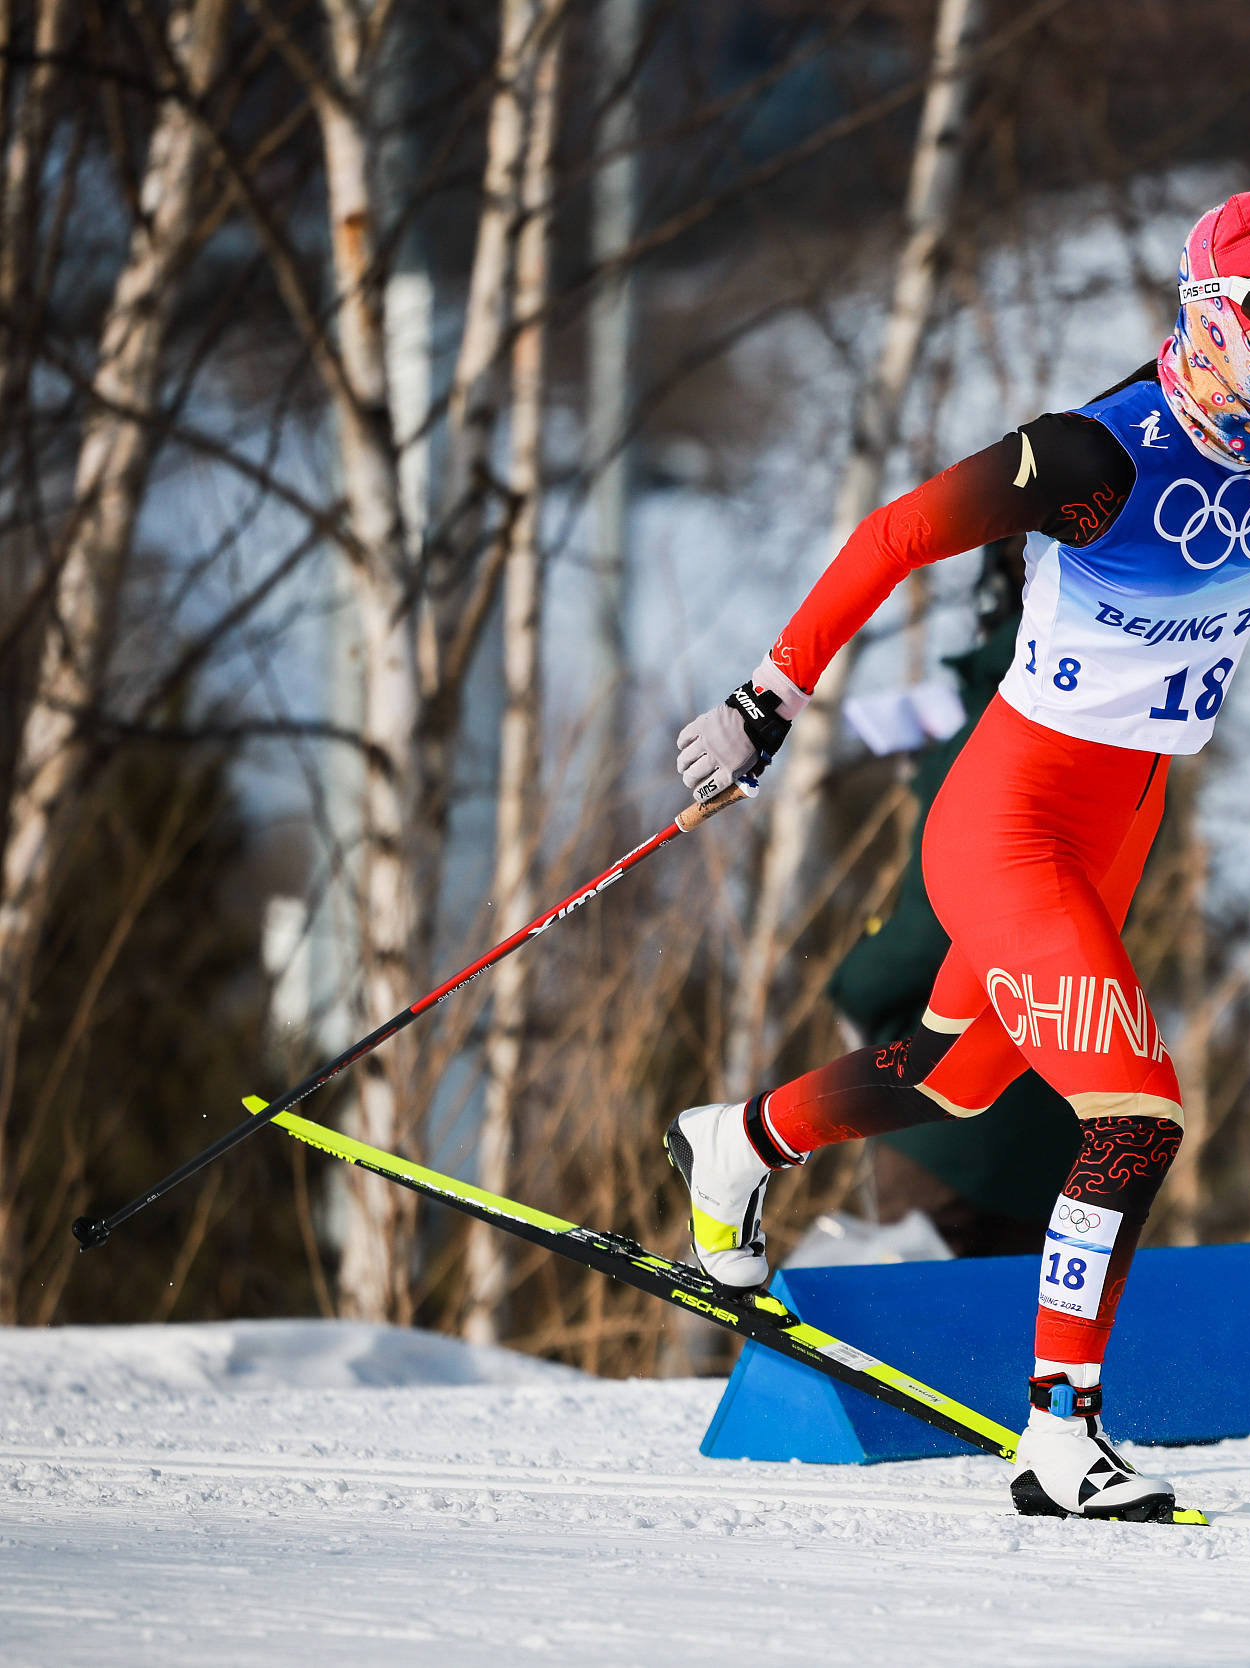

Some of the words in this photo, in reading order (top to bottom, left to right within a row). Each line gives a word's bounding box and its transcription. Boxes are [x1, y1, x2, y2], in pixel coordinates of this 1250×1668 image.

[1095, 601, 1228, 647] BEIJING
[733, 687, 765, 720] SWIX
[1149, 657, 1235, 722] 18
[1045, 1252, 1087, 1291] 18
[671, 1289, 739, 1326] FISCHER
[1060, 1300, 1083, 1312] 2022
